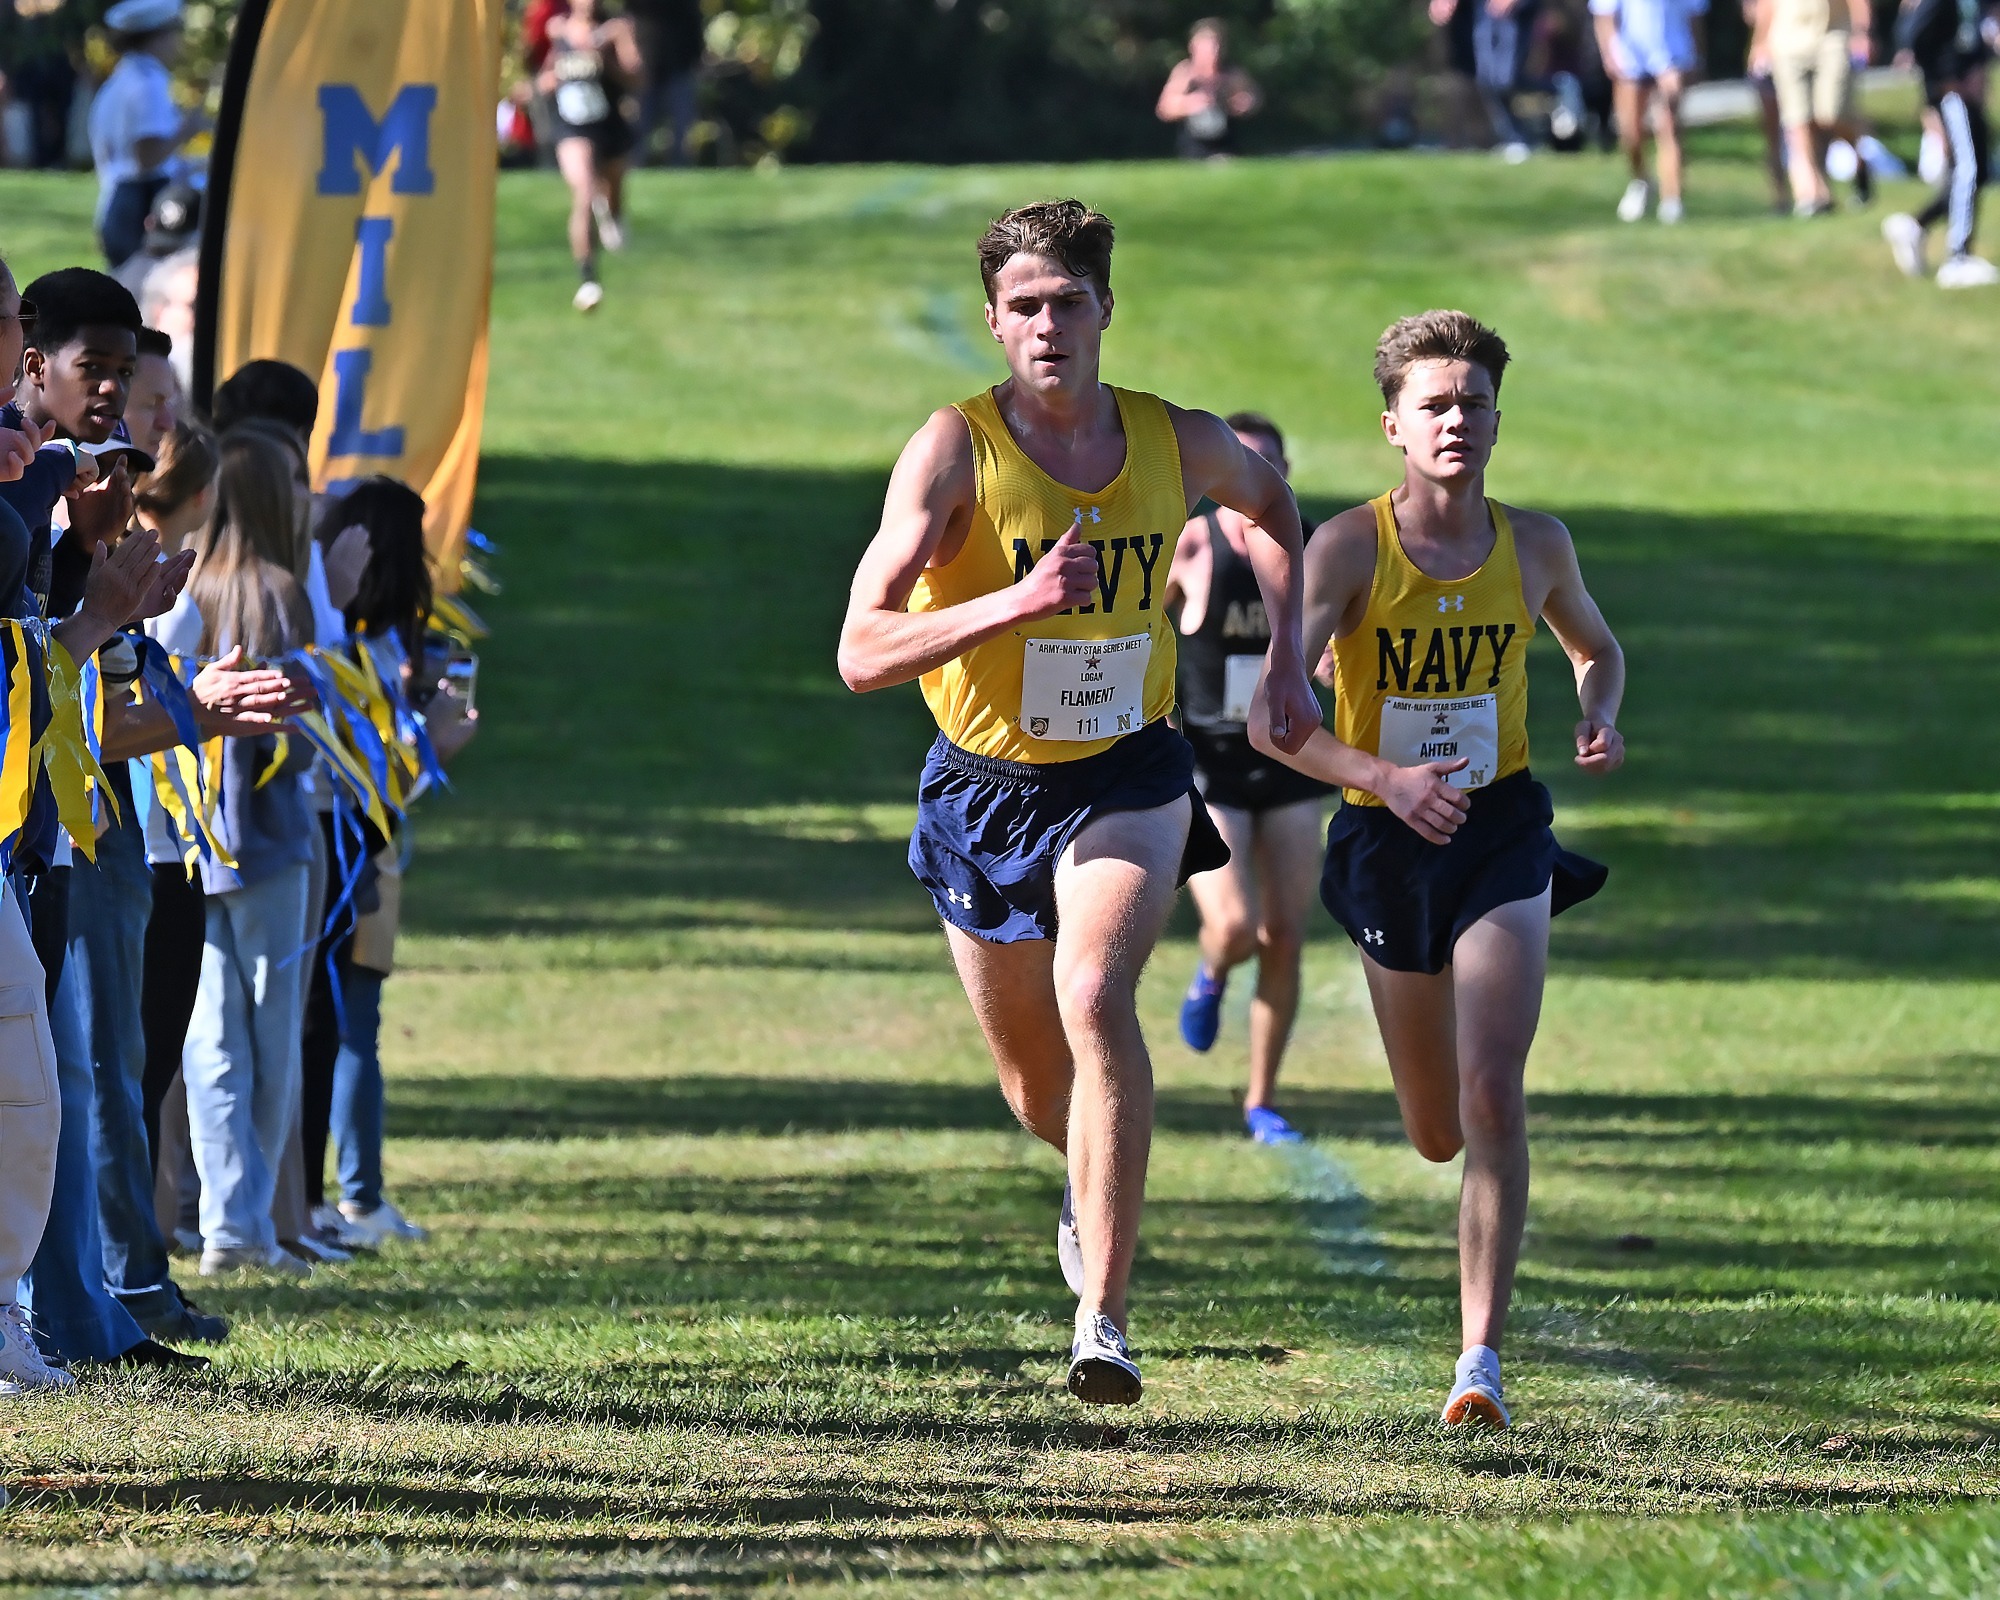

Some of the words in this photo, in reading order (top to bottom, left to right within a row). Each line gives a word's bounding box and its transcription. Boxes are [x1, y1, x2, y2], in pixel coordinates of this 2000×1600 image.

[316, 82, 438, 497] MIL
[1012, 532, 1164, 615] NVY
[1038, 643, 1082, 655] ARMY-NAVY
[1083, 645, 1102, 655] STAR
[1102, 641, 1125, 654] SERIES
[1124, 639, 1142, 651] MEET
[1376, 623, 1516, 693] NAVY
[1080, 671, 1104, 682] LOGAN
[1060, 686, 1116, 707] FLAMENT
[1392, 701, 1431, 712] ARMY-NAVY
[1432, 703, 1450, 712] STAR
[1450, 700, 1471, 711] SERIES
[1470, 698, 1487, 709] MEET
[1076, 716, 1099, 735] 111
[1116, 713, 1131, 731] N
[1430, 726, 1450, 735] OWEN
[1419, 741, 1458, 758] AHTEN
[1469, 769, 1485, 785] N
